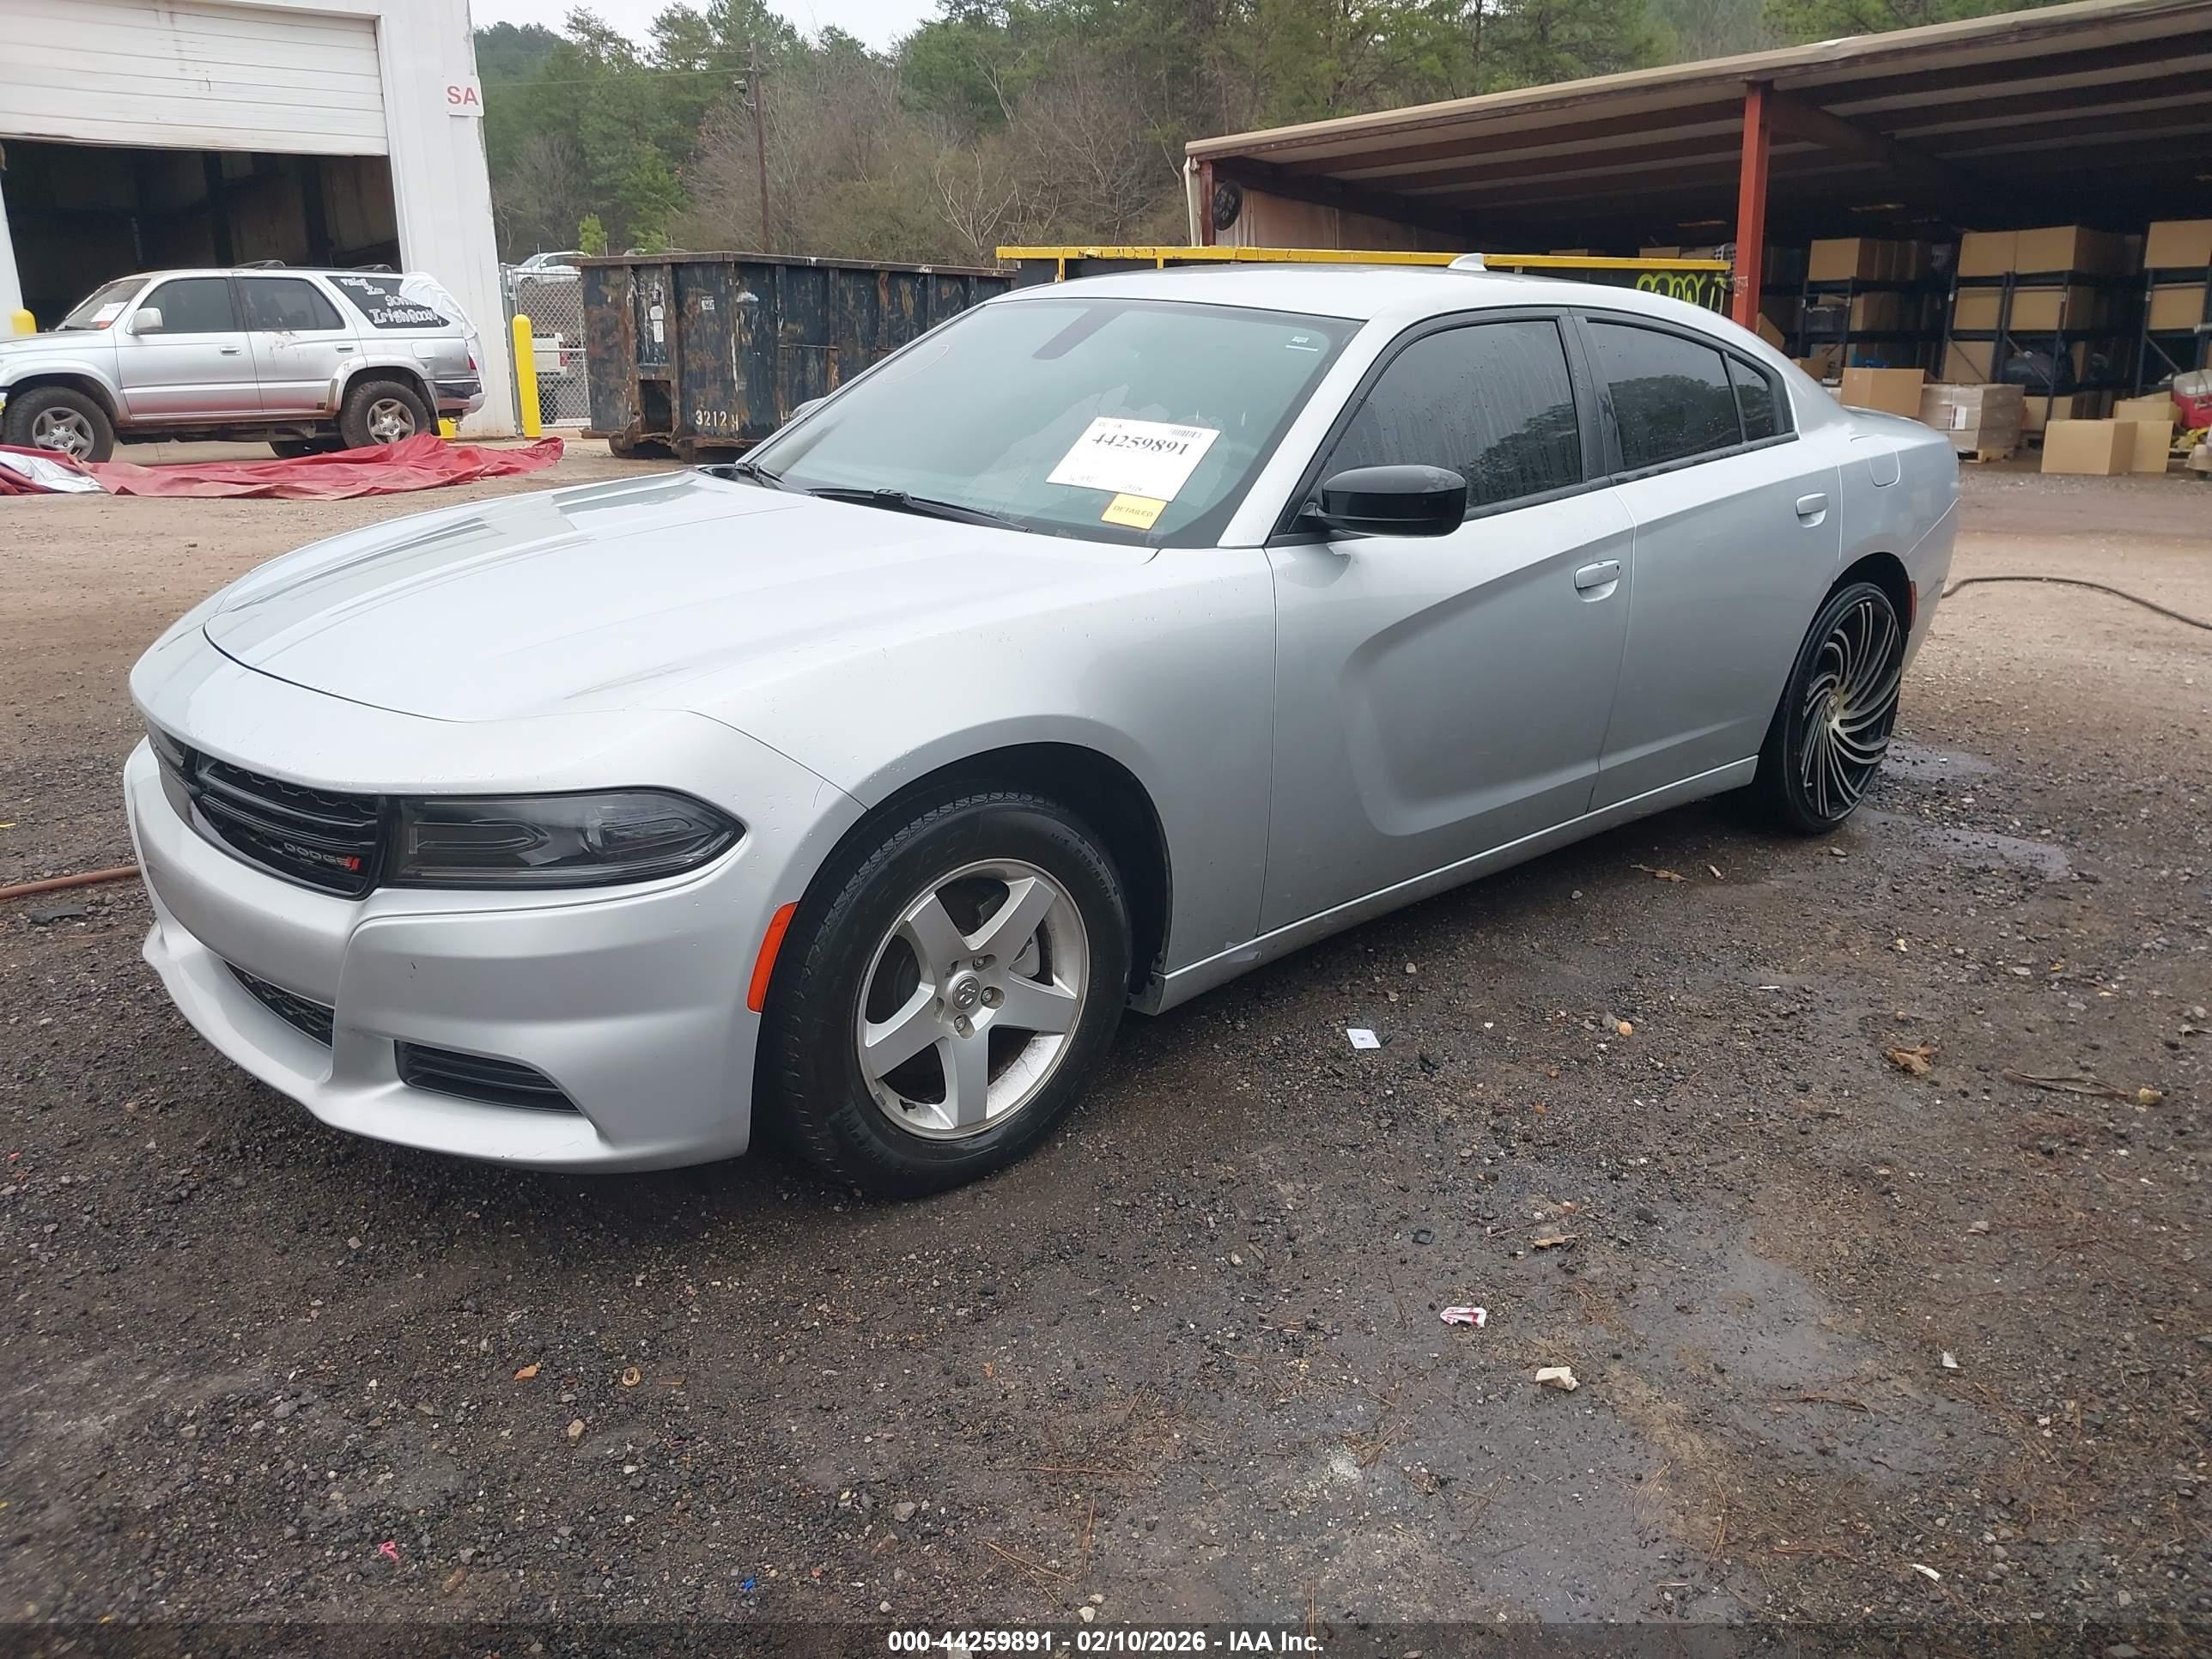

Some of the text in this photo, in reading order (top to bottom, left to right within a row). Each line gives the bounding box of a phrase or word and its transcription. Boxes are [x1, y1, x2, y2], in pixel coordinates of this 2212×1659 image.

[447, 85, 479, 106] SA
[1091, 432, 1190, 455] 44259891
[1112, 505, 1153, 518] DETAILED
[283, 842, 352, 867] DODGE
